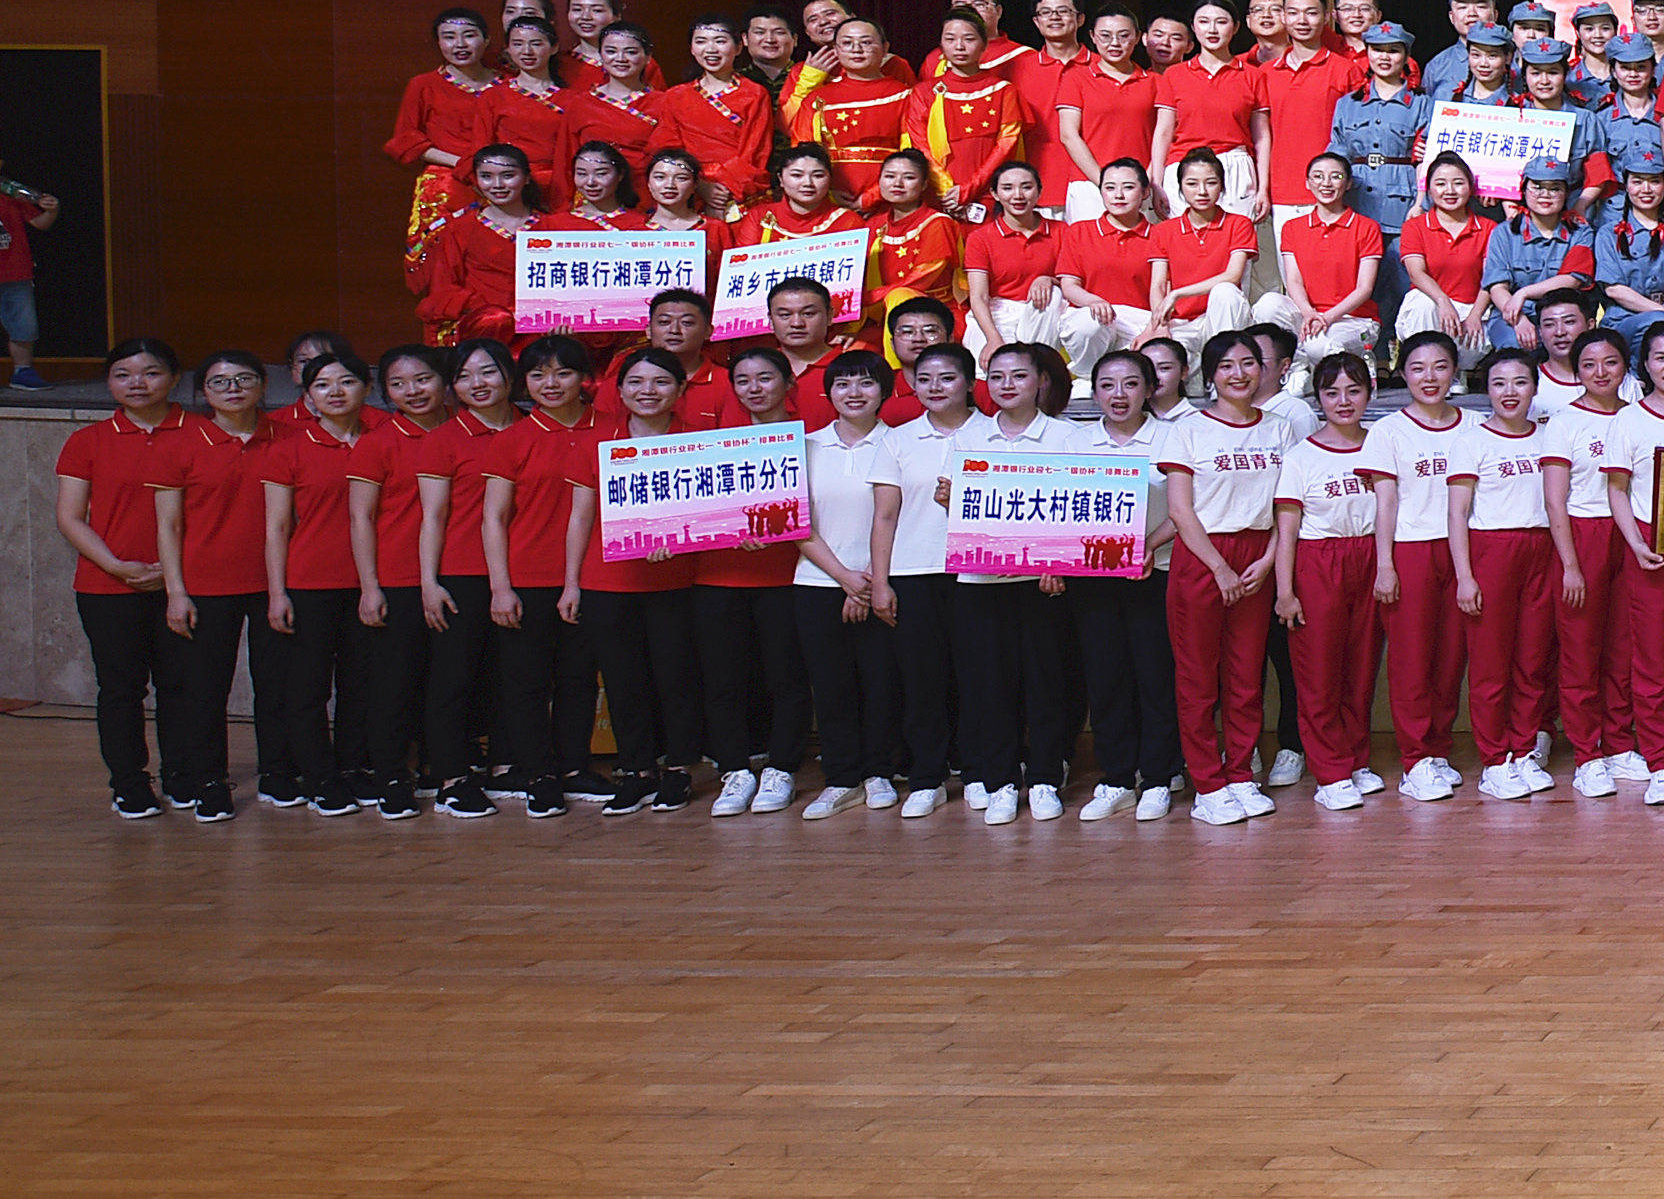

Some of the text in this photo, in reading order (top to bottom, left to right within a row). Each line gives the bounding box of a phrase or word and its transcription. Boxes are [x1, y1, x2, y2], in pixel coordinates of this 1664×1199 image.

[1436, 128, 1561, 160] 中信银行湘潭分行
[528, 259, 694, 289] 招商银行湘潭分行
[1214, 452, 1282, 472] 爱国青年
[1415, 458, 1447, 478] 爱国
[607, 456, 799, 507] 邮储银行湘潭市分行
[962, 486, 1135, 524] 韶山光大村镇银行
